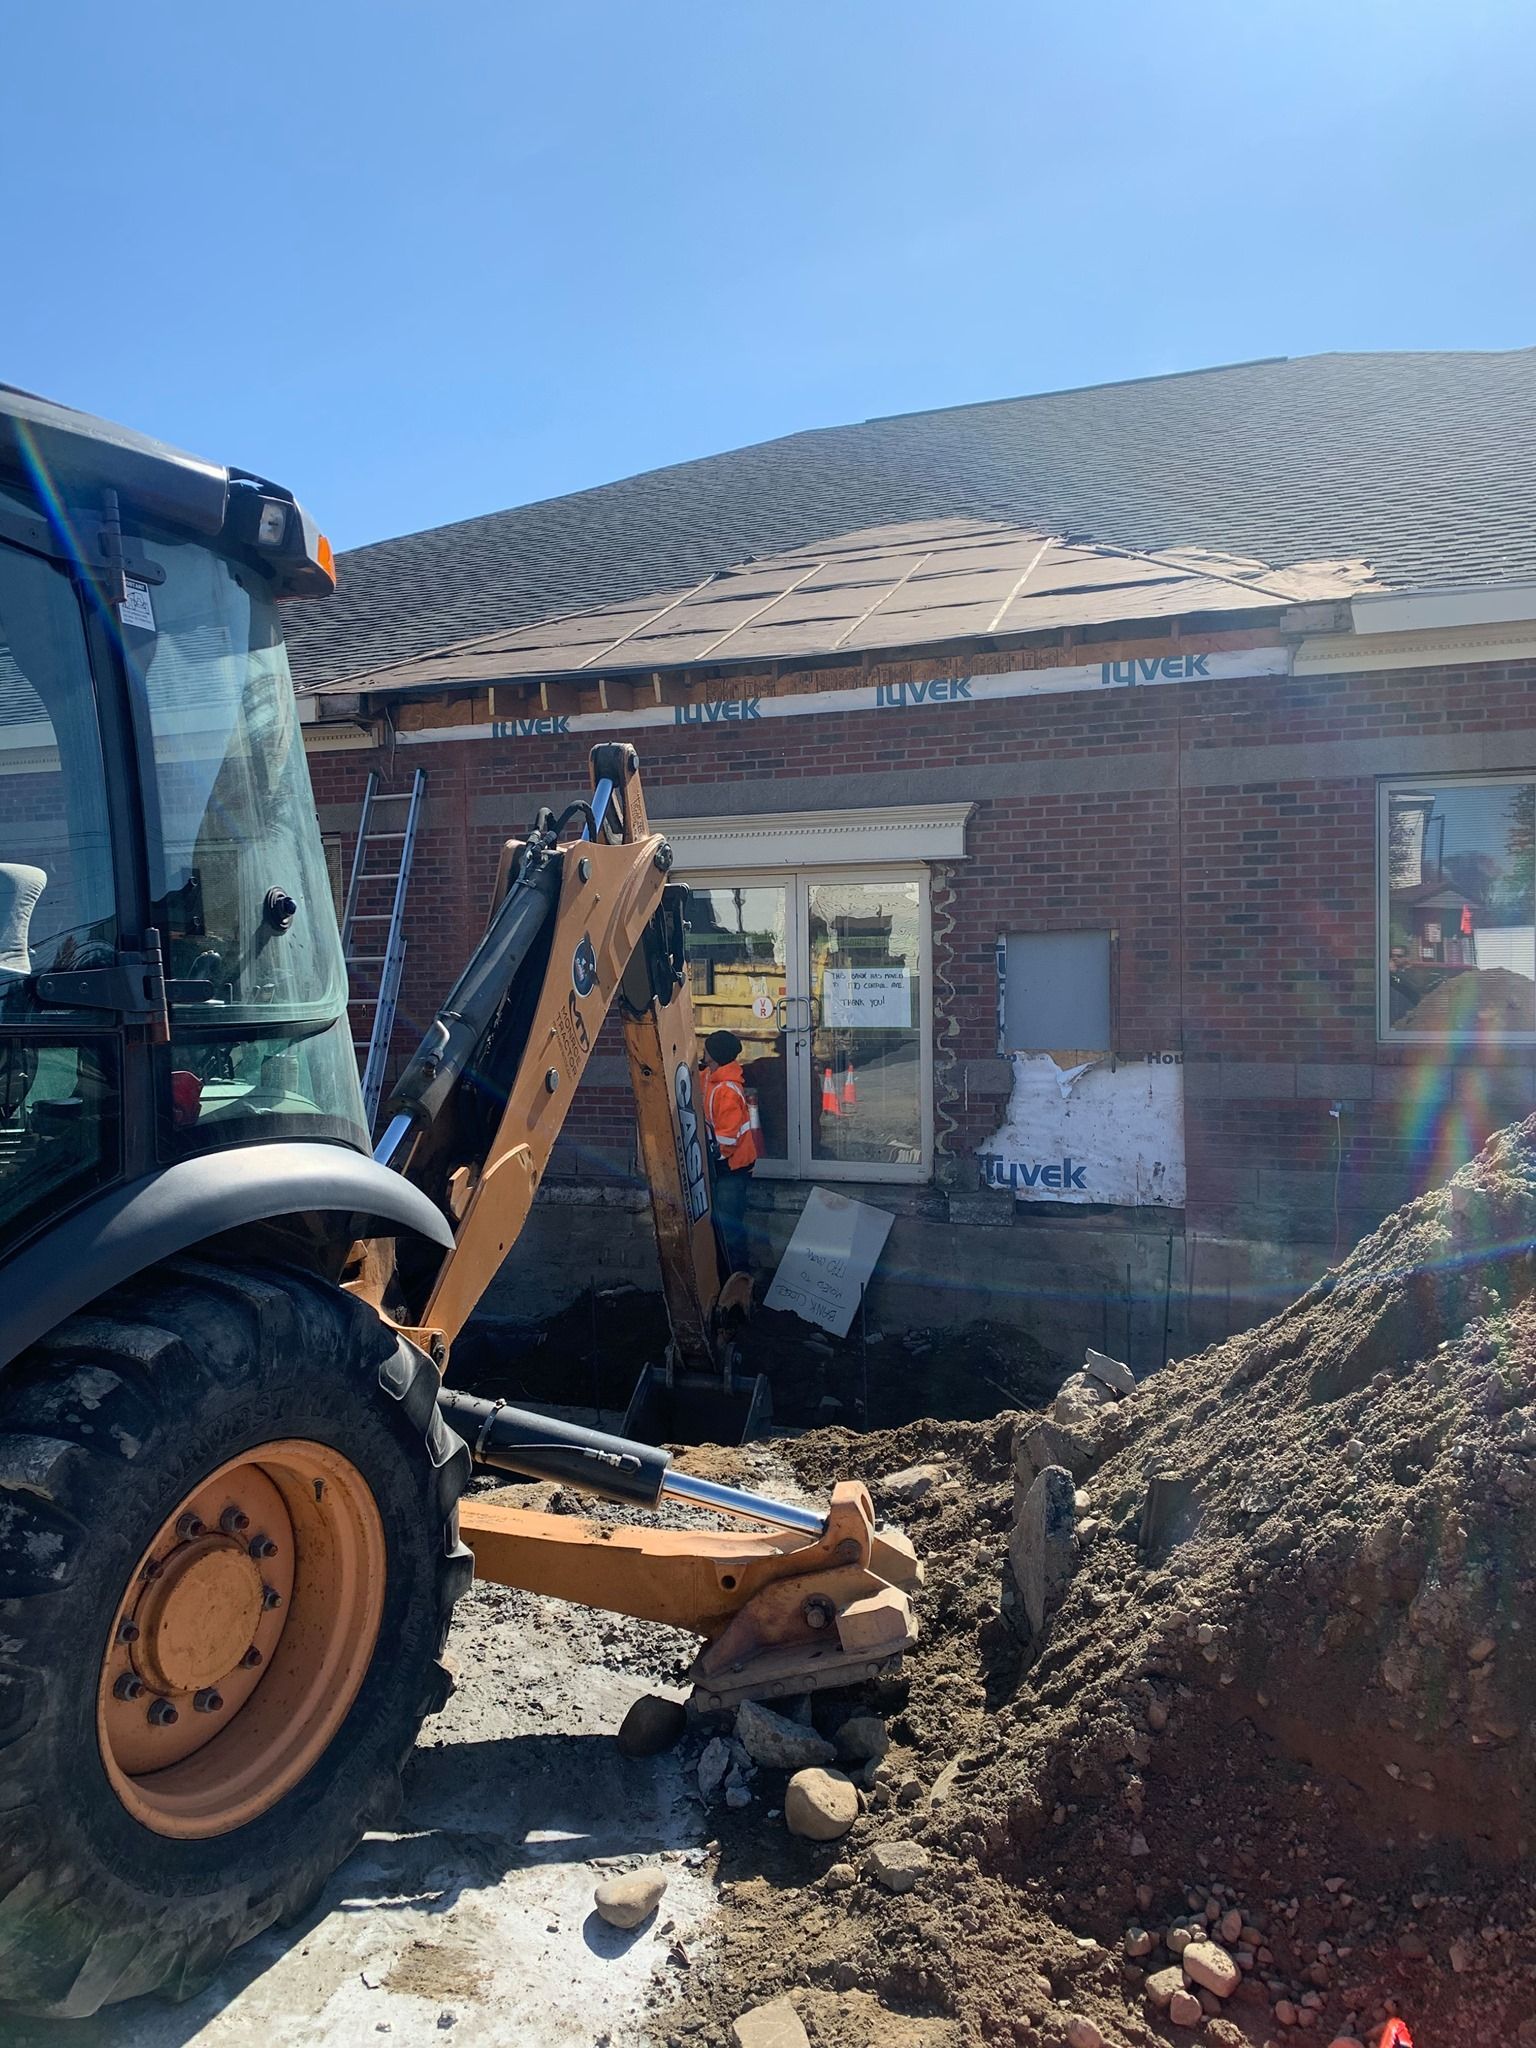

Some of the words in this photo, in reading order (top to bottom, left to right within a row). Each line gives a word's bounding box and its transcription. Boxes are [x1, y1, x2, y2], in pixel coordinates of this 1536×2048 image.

[760, 1008, 766, 1016] R
[843, 999, 865, 1007] THANK
[869, 995, 885, 1007] YOU!
[557, 1012, 577, 1076] TRACTOR
[561, 1005, 581, 1067] MONROE
[675, 1062, 709, 1224] CASE
[978, 1154, 1088, 1190] Tyvek
[800, 1271, 811, 1283] TO
[809, 1298, 838, 1322] BANK
